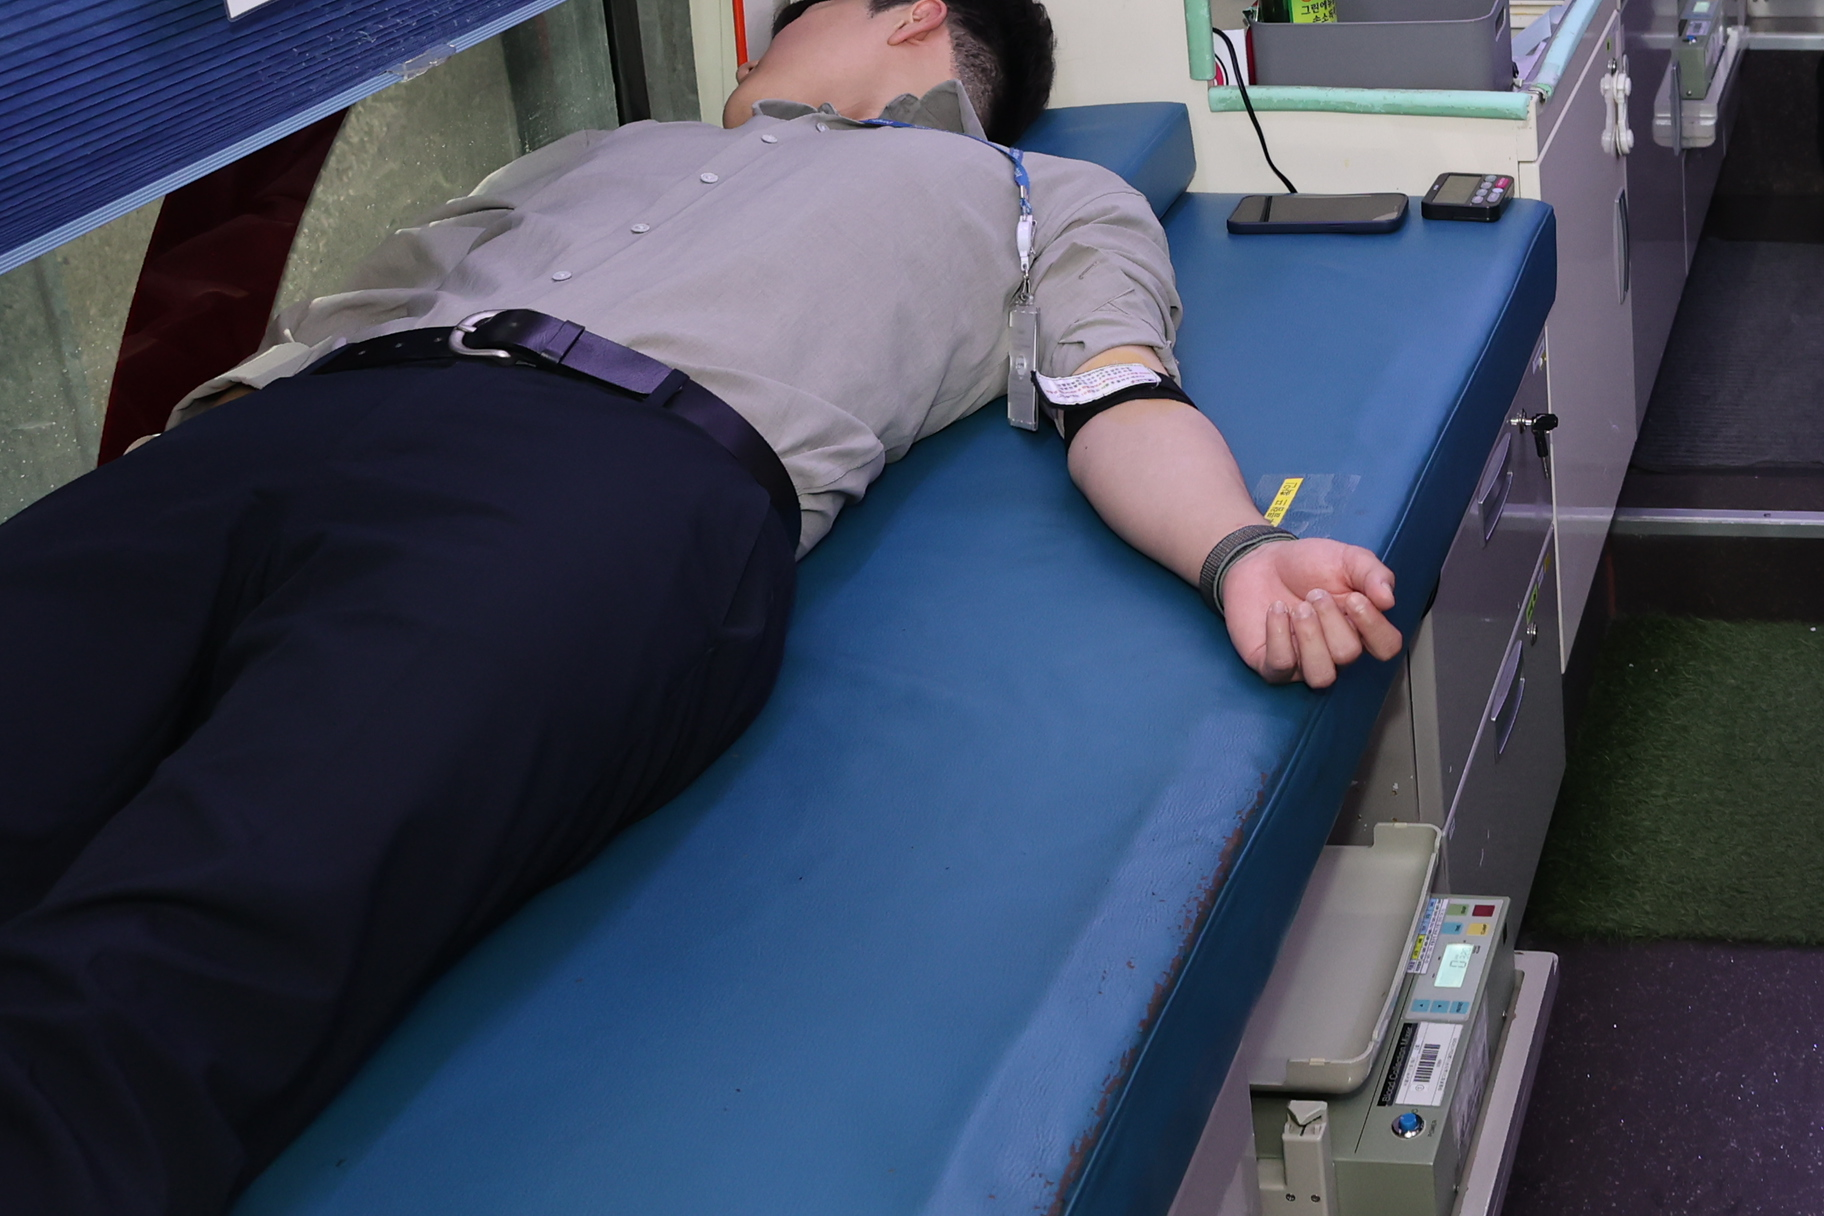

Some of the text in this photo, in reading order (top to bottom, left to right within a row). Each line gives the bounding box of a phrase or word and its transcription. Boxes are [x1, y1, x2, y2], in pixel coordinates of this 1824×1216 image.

[1382, 1026, 1413, 1103] Blood Collection Mixer
[1428, 1119, 1438, 1138] POWER
